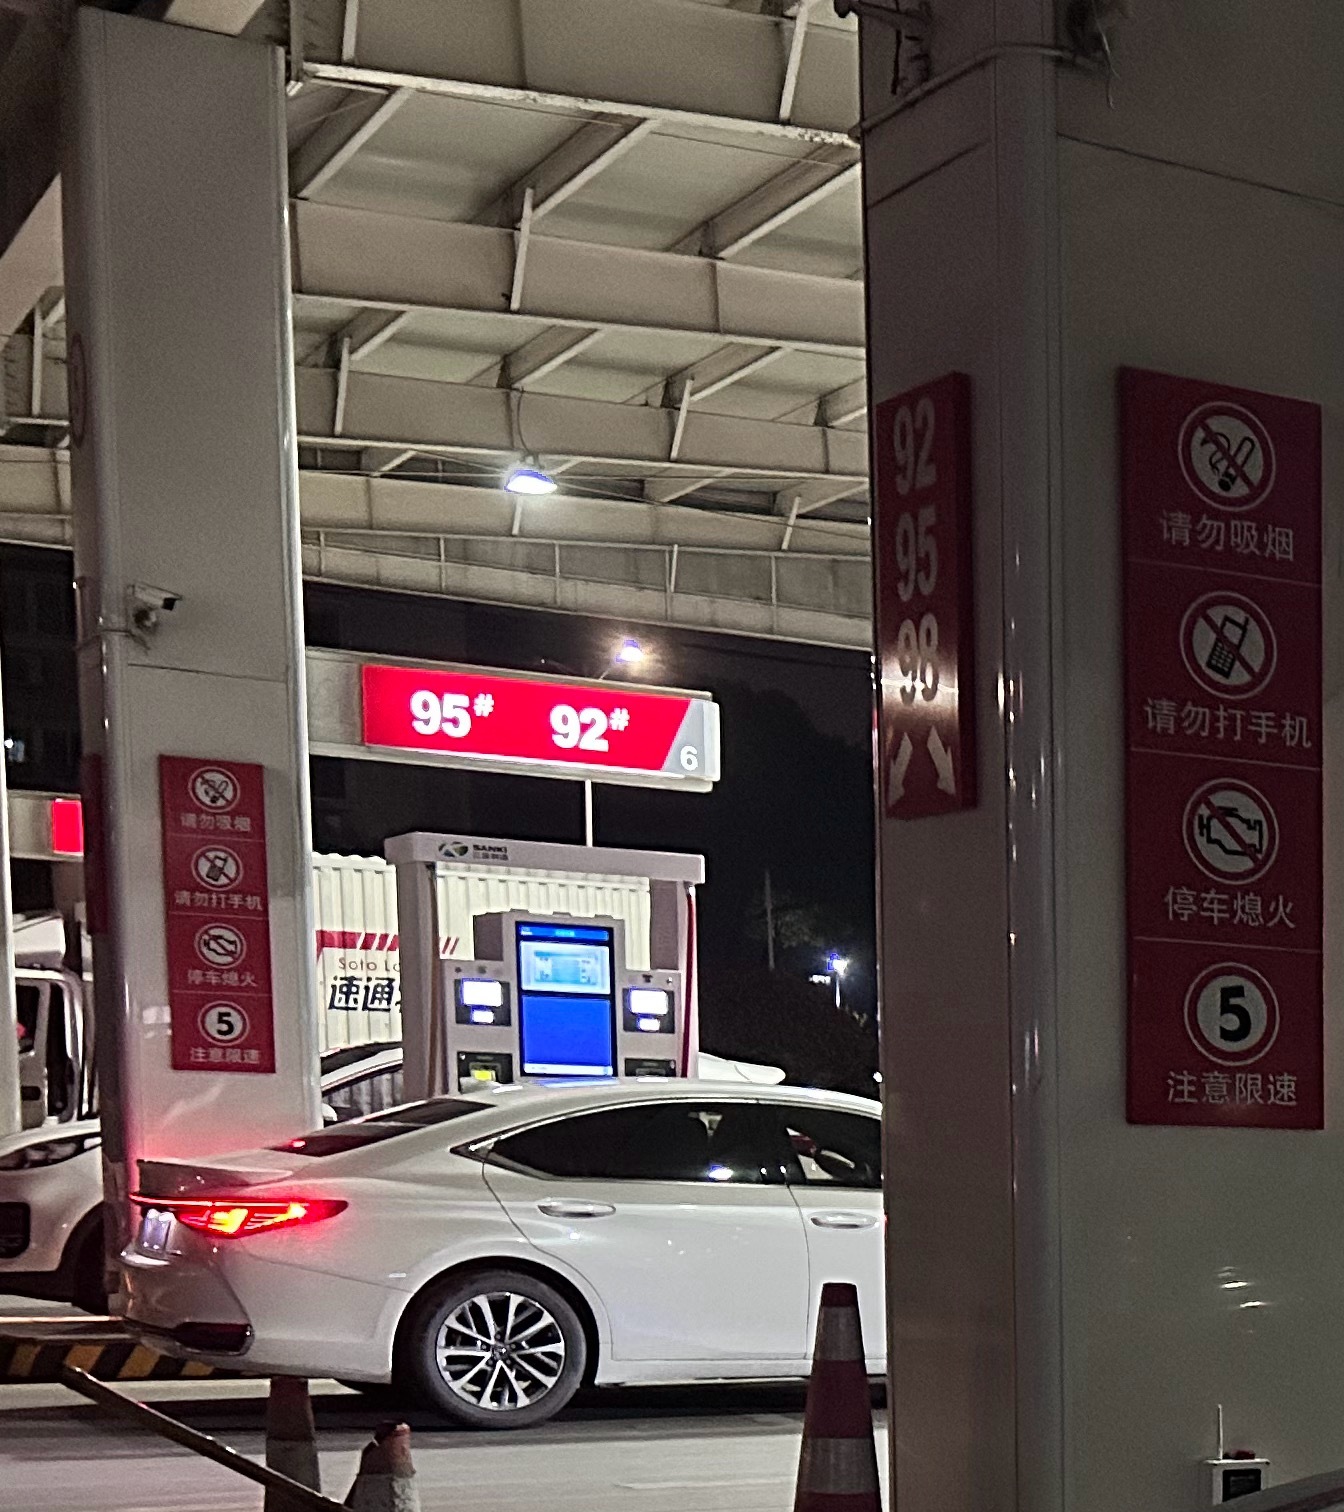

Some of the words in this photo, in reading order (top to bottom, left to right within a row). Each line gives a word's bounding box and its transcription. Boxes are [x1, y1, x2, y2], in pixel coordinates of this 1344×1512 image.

[893, 397, 937, 496] 92
[895, 503, 939, 603] 95
[1158, 509, 1295, 562] 请勿吸烟
[896, 611, 941, 707] 98
[409, 689, 495, 738] 95#
[549, 704, 631, 753] 92#
[1143, 697, 1313, 749] 请勿打手机
[680, 745, 698, 772] 6
[1164, 885, 1296, 929] 停车熄火
[328, 975, 402, 1013] 速通
[1219, 985, 1252, 1043] 5
[215, 1011, 235, 1037] 5
[1166, 1070, 1298, 1107] 注意限速
